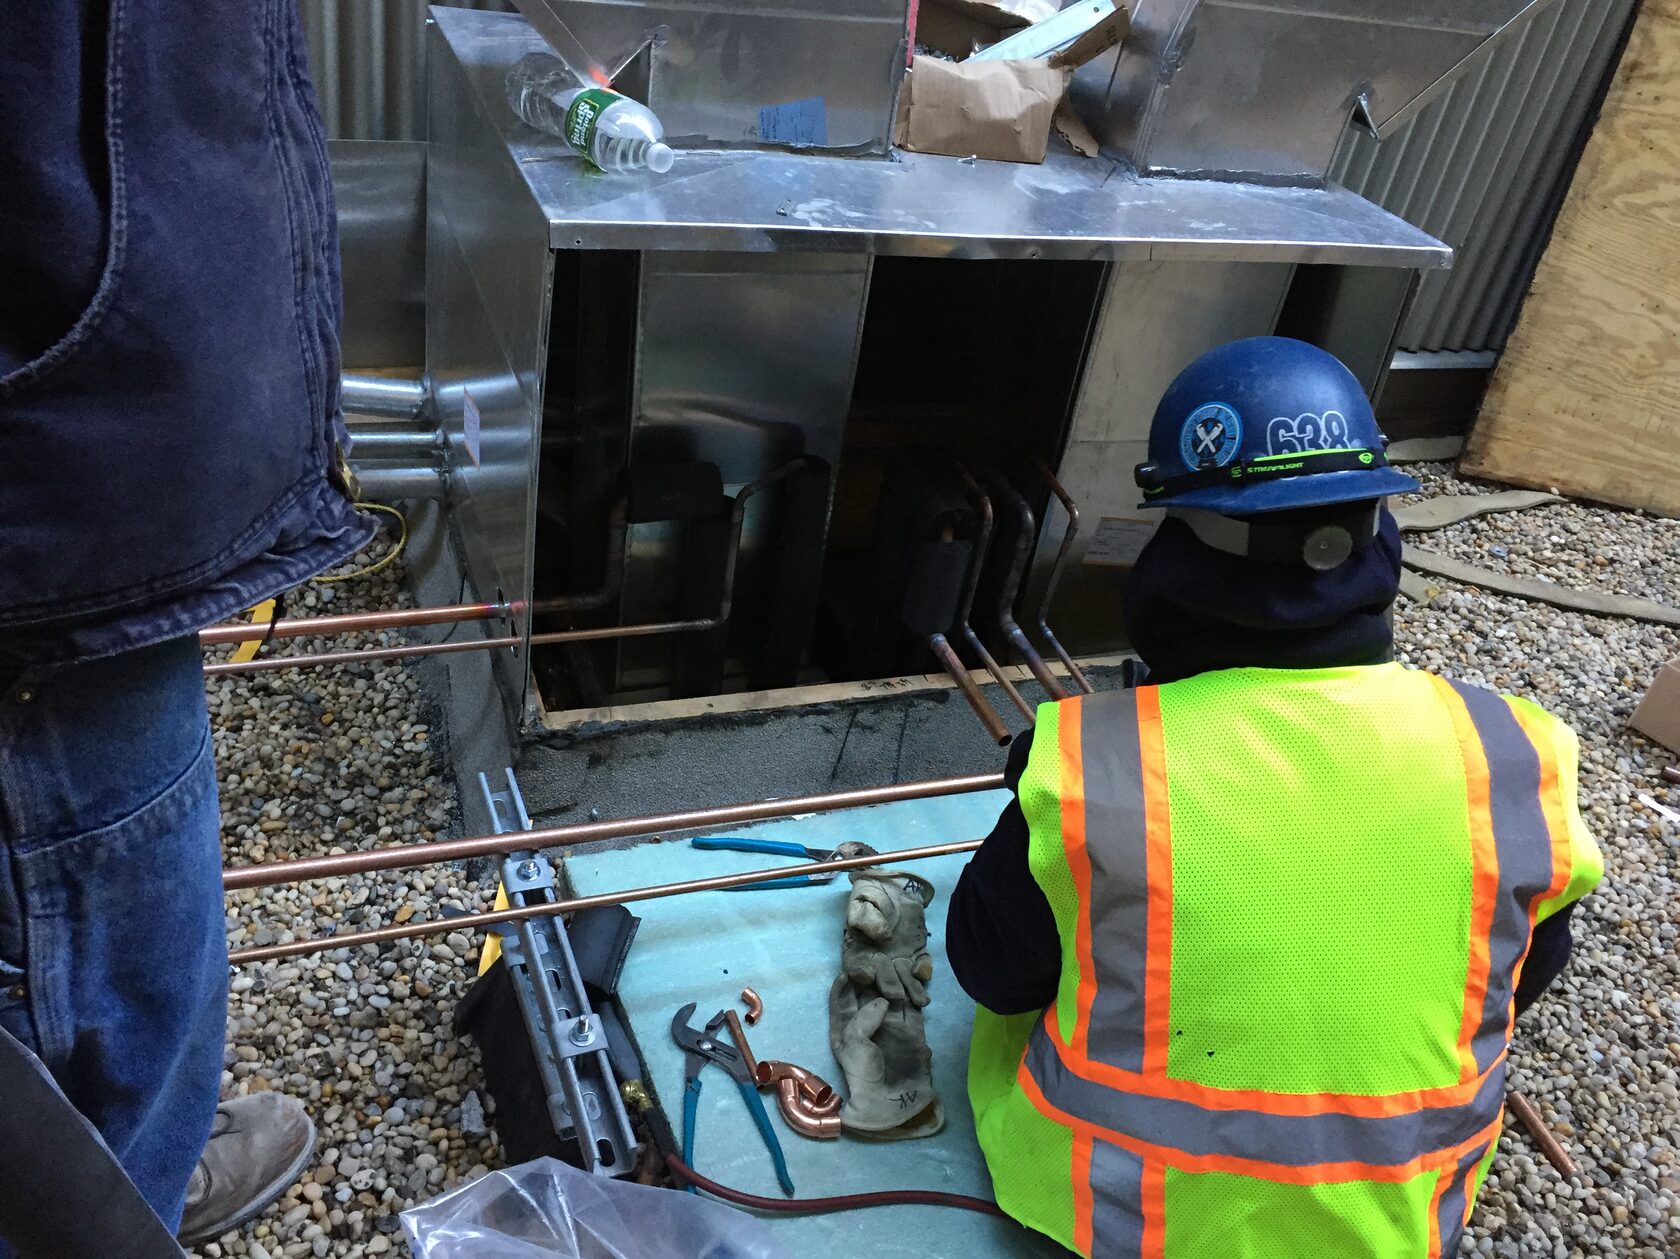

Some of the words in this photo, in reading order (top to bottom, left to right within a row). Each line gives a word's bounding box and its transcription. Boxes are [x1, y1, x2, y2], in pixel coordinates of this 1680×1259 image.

[570, 101, 590, 145] Spring
[580, 110, 595, 146] Poland
[1267, 410, 1351, 456] 638
[1247, 462, 1304, 473] STREAMLIGHT
